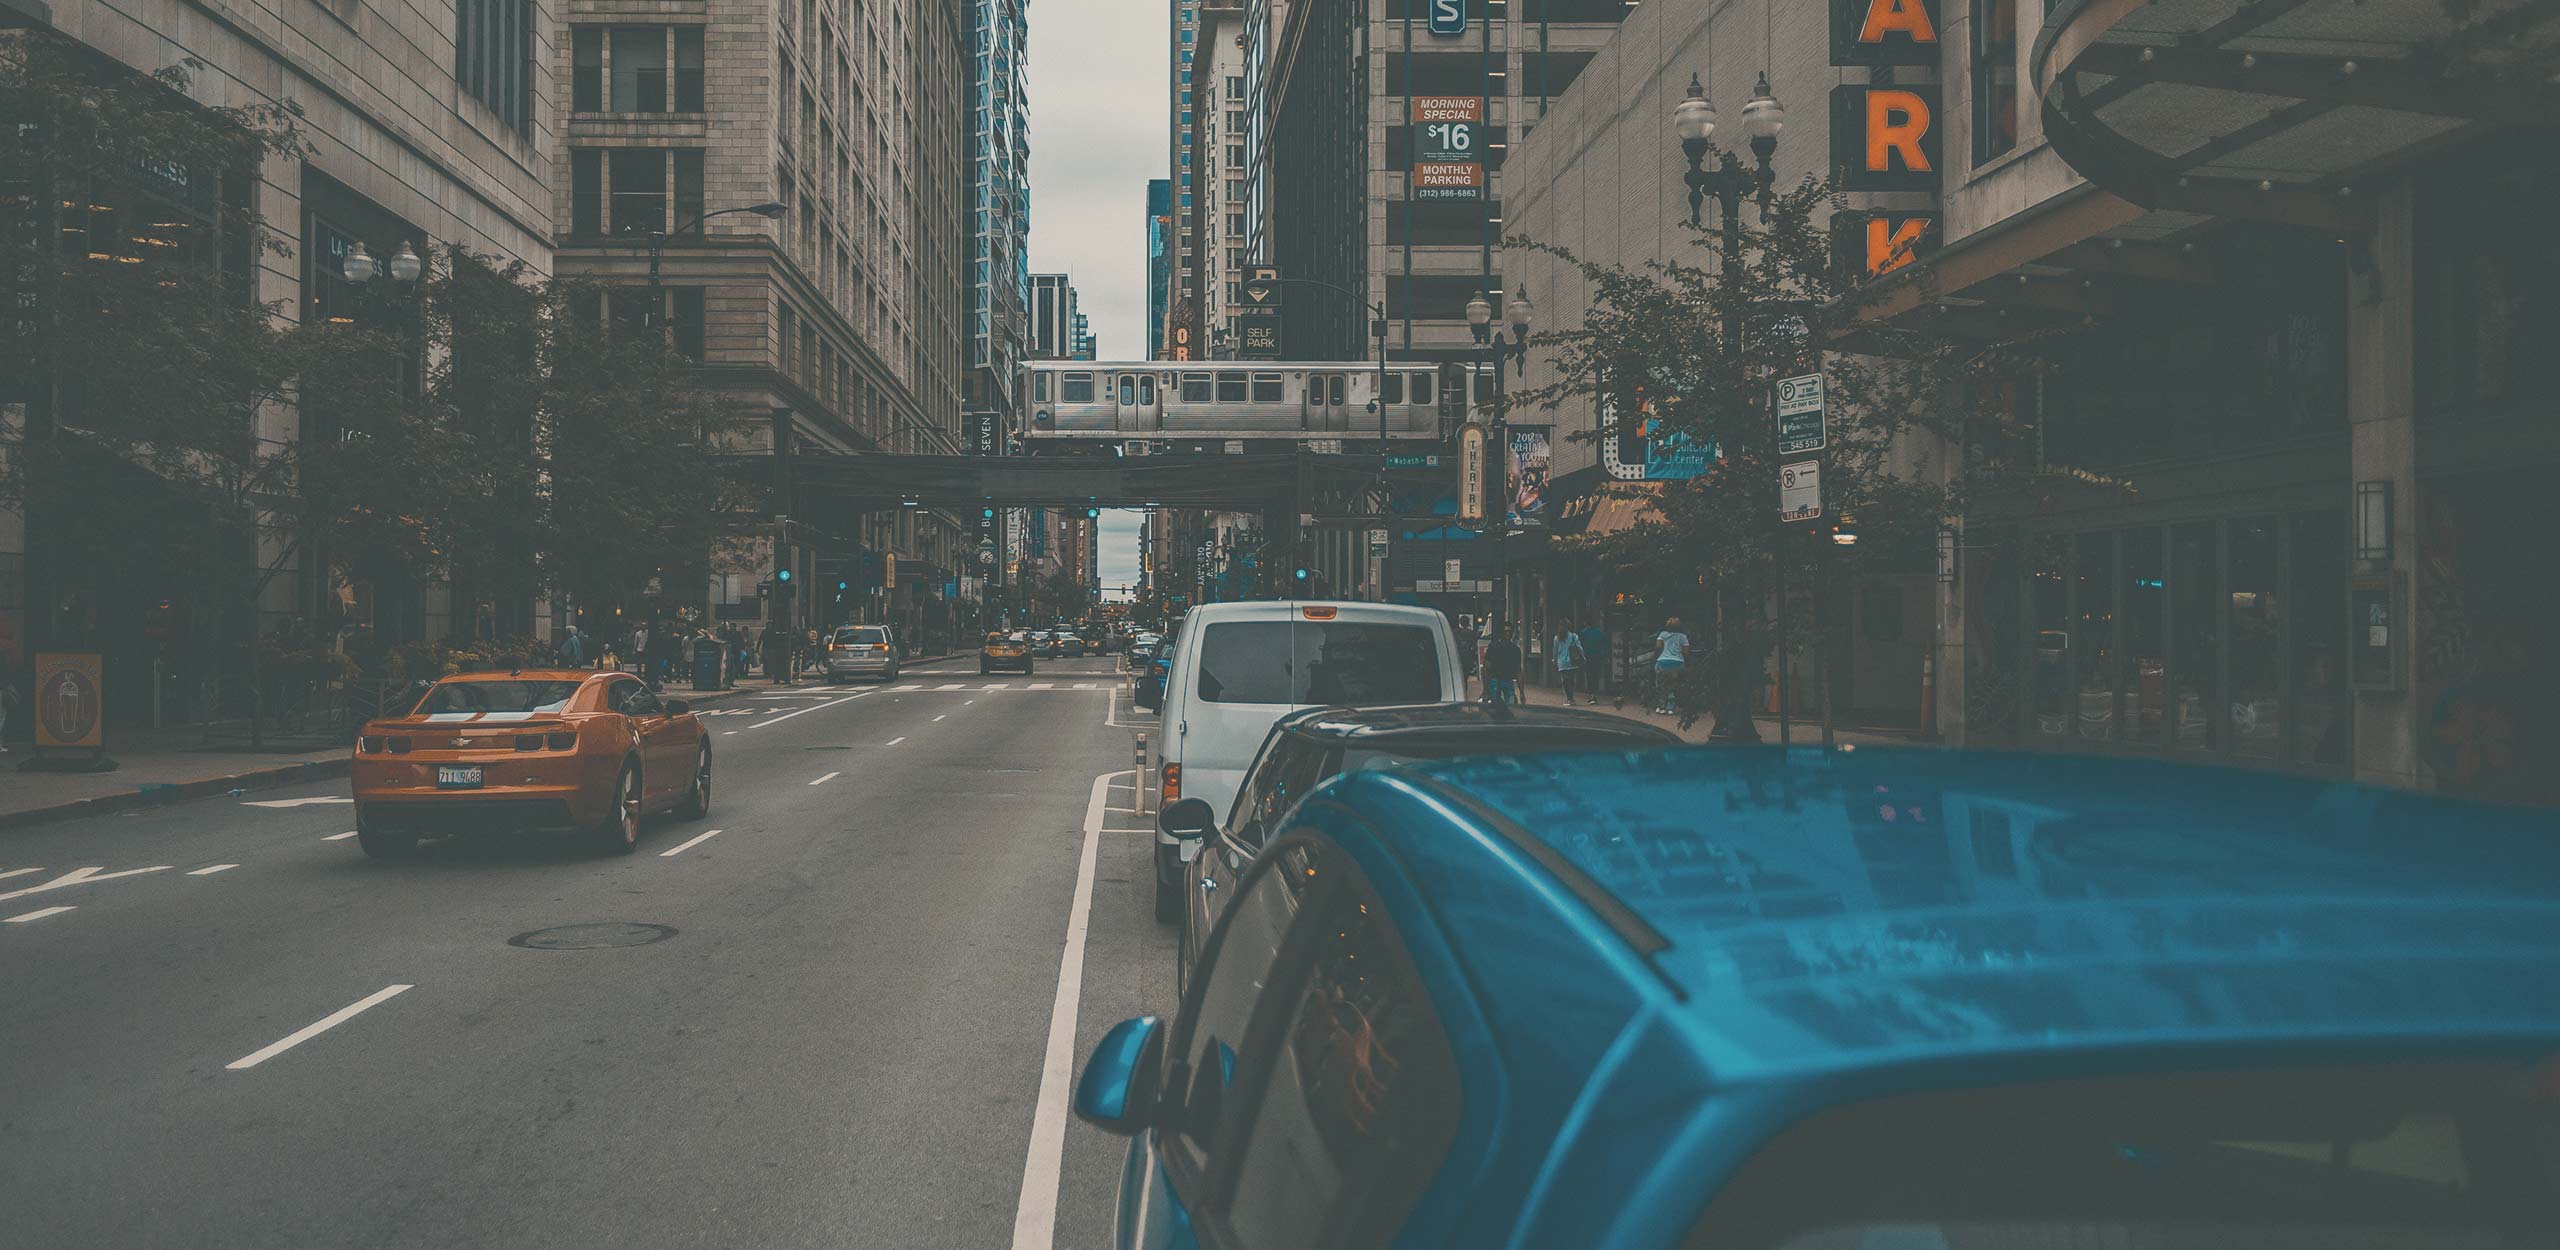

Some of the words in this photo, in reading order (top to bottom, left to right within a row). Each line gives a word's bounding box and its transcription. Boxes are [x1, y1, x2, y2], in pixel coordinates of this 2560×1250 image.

[1420, 99, 1475, 109] MORNING
[1423, 110, 1472, 120] SPECIAL
[1428, 123, 1470, 151] $16
[1423, 165, 1473, 175] MONTHLY
[1424, 175, 1471, 185] PARKING
[1419, 189, 1438, 199] (312)
[1440, 189, 1476, 198] 986-6863
[331, 235, 343, 258] LA
[1247, 327, 1272, 338] SELF
[1247, 338, 1275, 348] PARK
[1808, 399, 1819, 407] BOX
[981, 417, 991, 450] SEVEN
[1805, 438, 1818, 449] 519
[1394, 457, 1420, 465] Wabash
[1521, 452, 1547, 462] YOUTH
[1675, 455, 1704, 465] center
